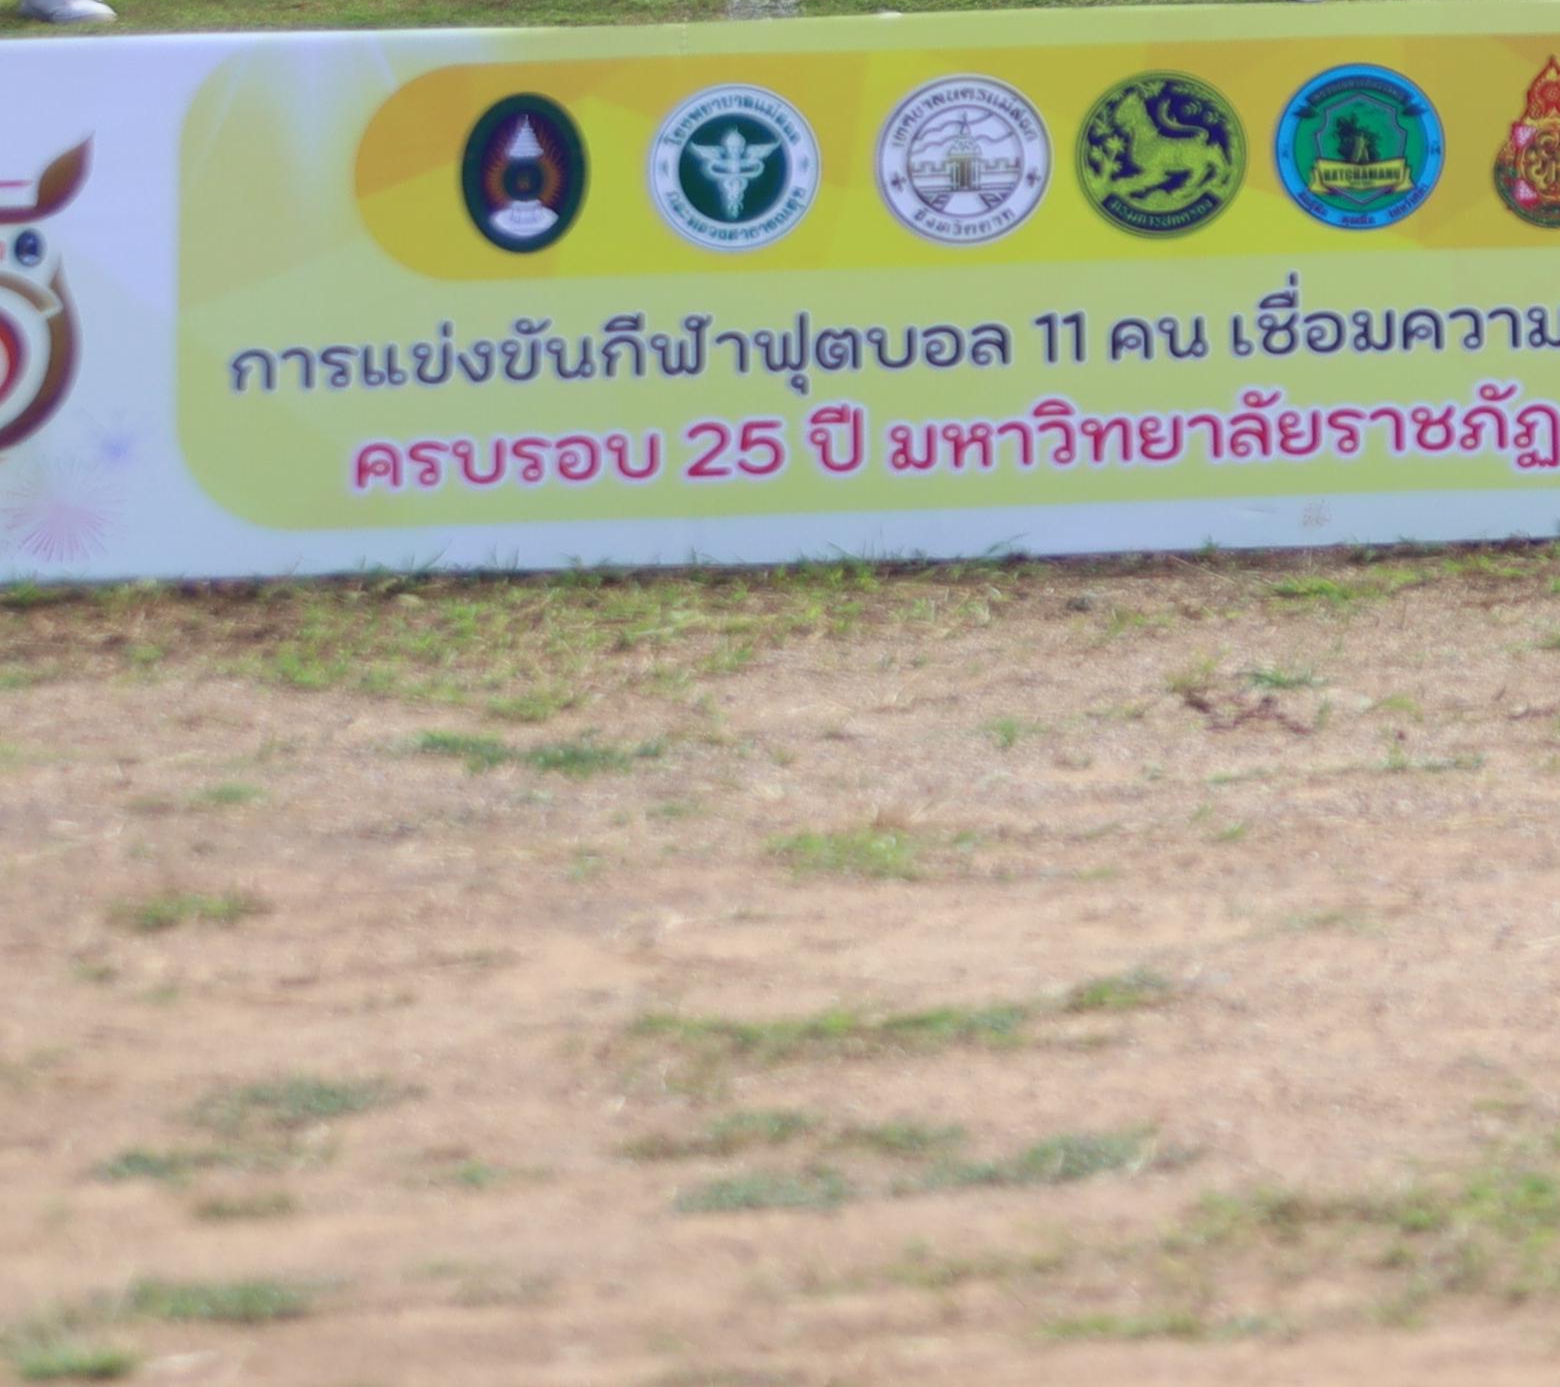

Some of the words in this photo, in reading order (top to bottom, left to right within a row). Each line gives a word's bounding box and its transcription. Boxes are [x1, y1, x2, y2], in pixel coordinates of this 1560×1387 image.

[231, 309, 1010, 396] การแข่งขันกีฬาฟุตบอล
[1035, 311, 1087, 363] 11
[1109, 313, 1208, 362] คน
[352, 434, 660, 489] ครบรอบ
[686, 419, 785, 478] 25
[807, 403, 863, 474] ปี
